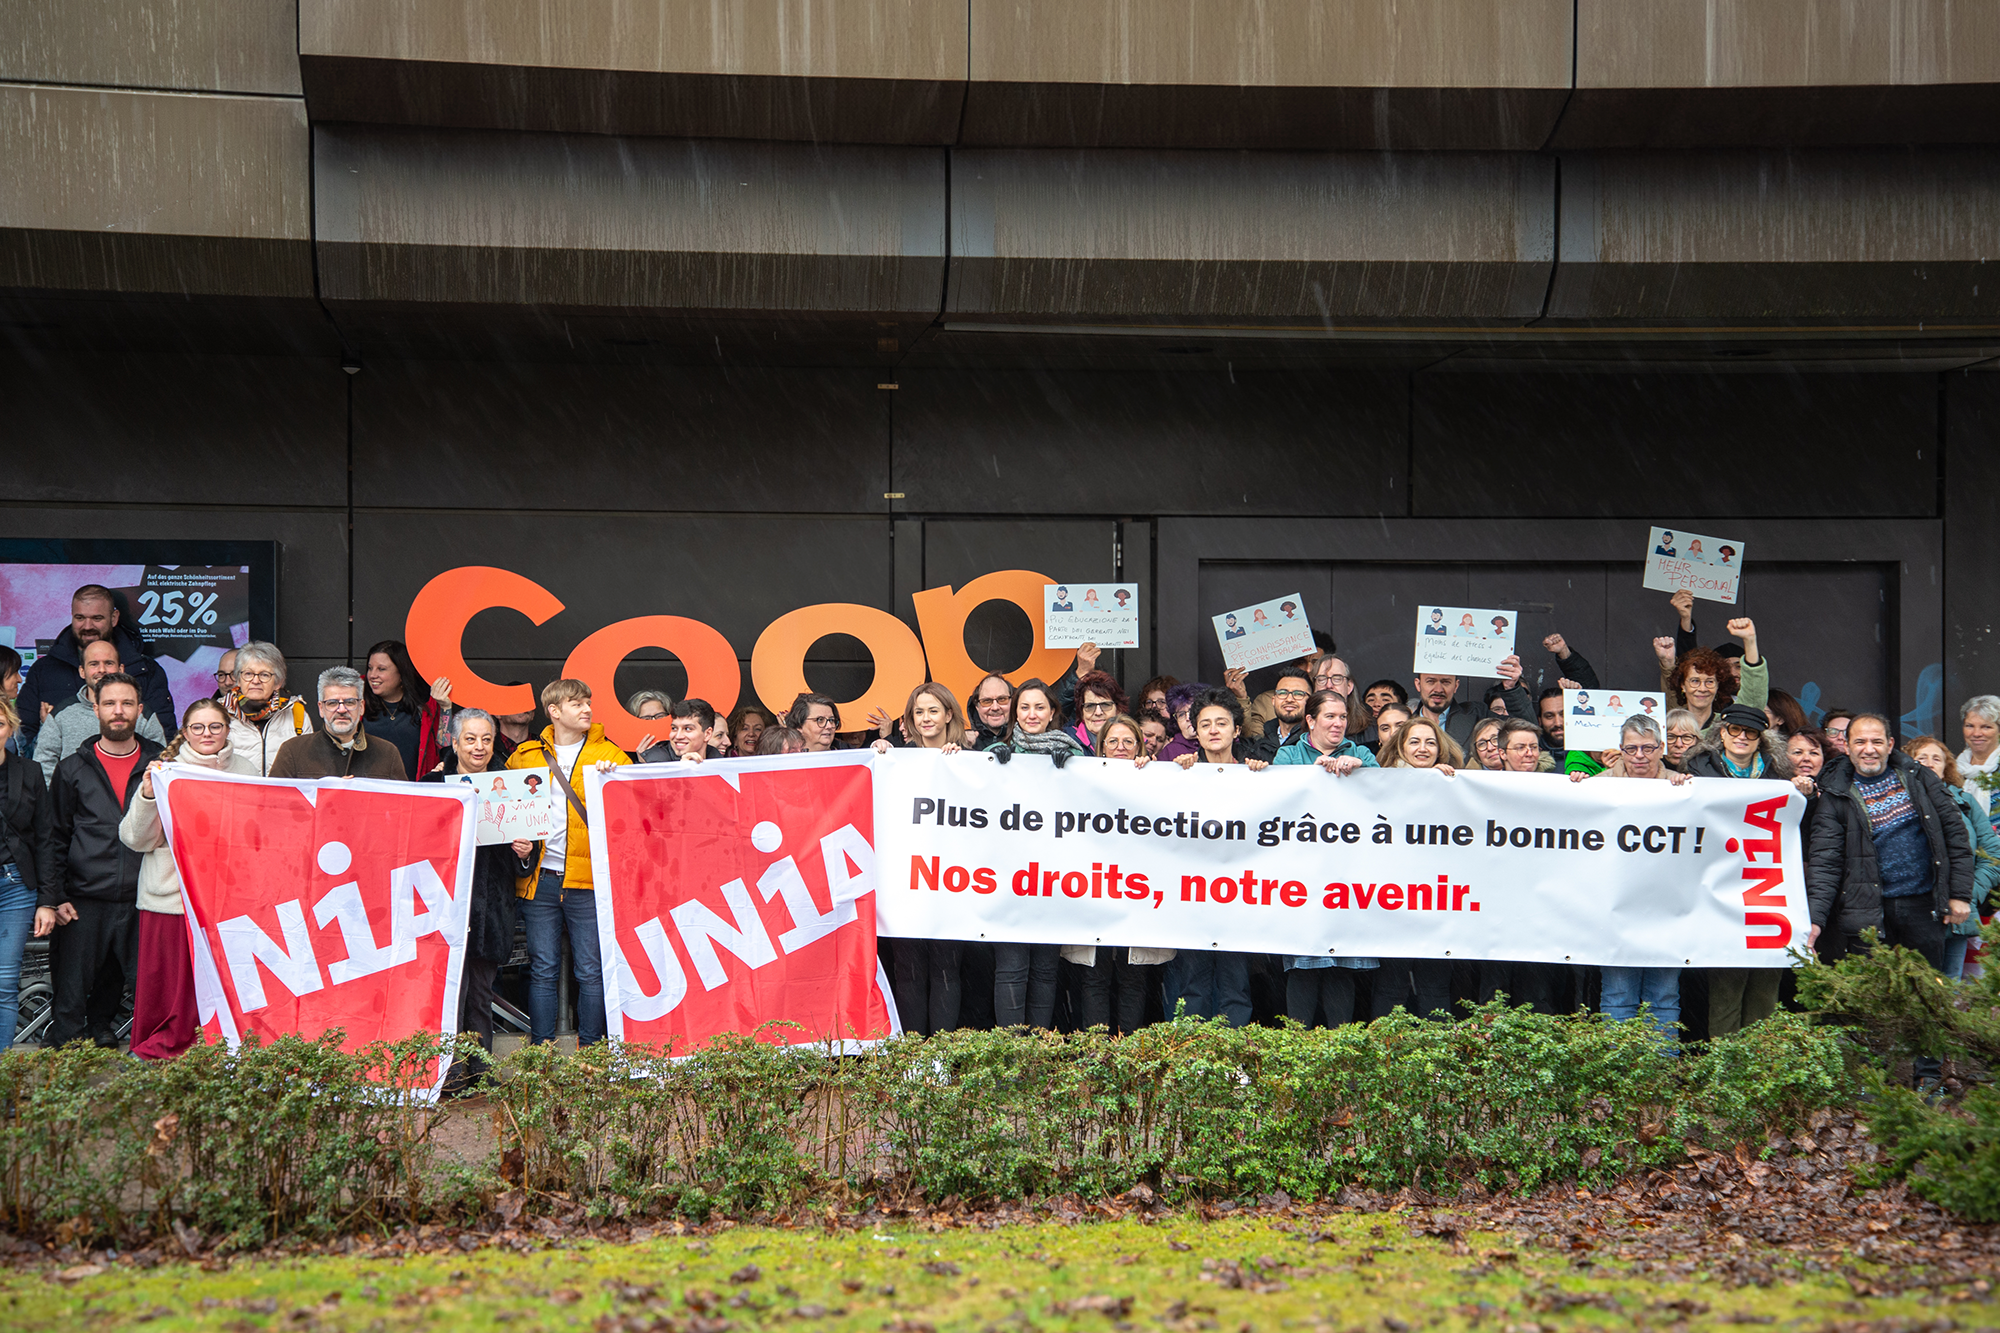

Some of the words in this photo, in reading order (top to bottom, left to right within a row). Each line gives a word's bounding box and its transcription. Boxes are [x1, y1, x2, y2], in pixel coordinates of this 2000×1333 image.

[1658, 558, 1692, 574] MEHR
[1663, 571, 1737, 595] PERSONAL
[137, 590, 219, 626] 25%
[1230, 630, 1311, 663] RECONNAISSANCE
[505, 815, 518, 824] LA
[912, 797, 989, 829] Plus
[1000, 803, 1044, 831] de
[1054, 808, 1246, 841] protection
[1256, 812, 1361, 847] grâce
[1371, 813, 1393, 844] à
[1405, 823, 1475, 847] une
[1485, 819, 1605, 852] bonne
[1616, 824, 1688, 855] CCT
[909, 854, 998, 895] Nos
[1011, 861, 1164, 910] droits,
[1180, 870, 1308, 908] notre
[1322, 874, 1481, 912] avenir.
